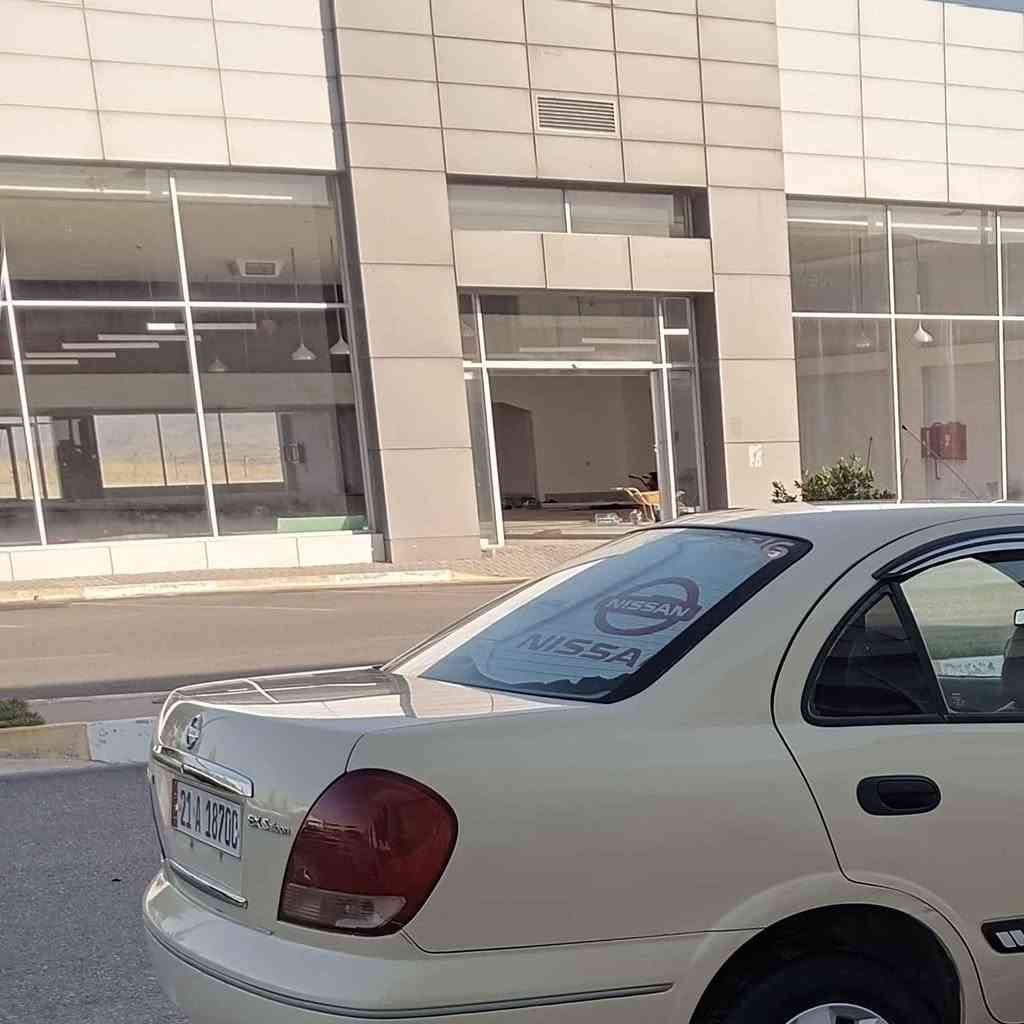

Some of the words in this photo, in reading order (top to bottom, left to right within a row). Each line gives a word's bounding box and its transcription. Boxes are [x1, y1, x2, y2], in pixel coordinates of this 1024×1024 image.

[606, 597, 691, 618] NISSAN
[516, 632, 643, 668] NISSA
[180, 789, 192, 829] 21
[194, 795, 201, 833] A
